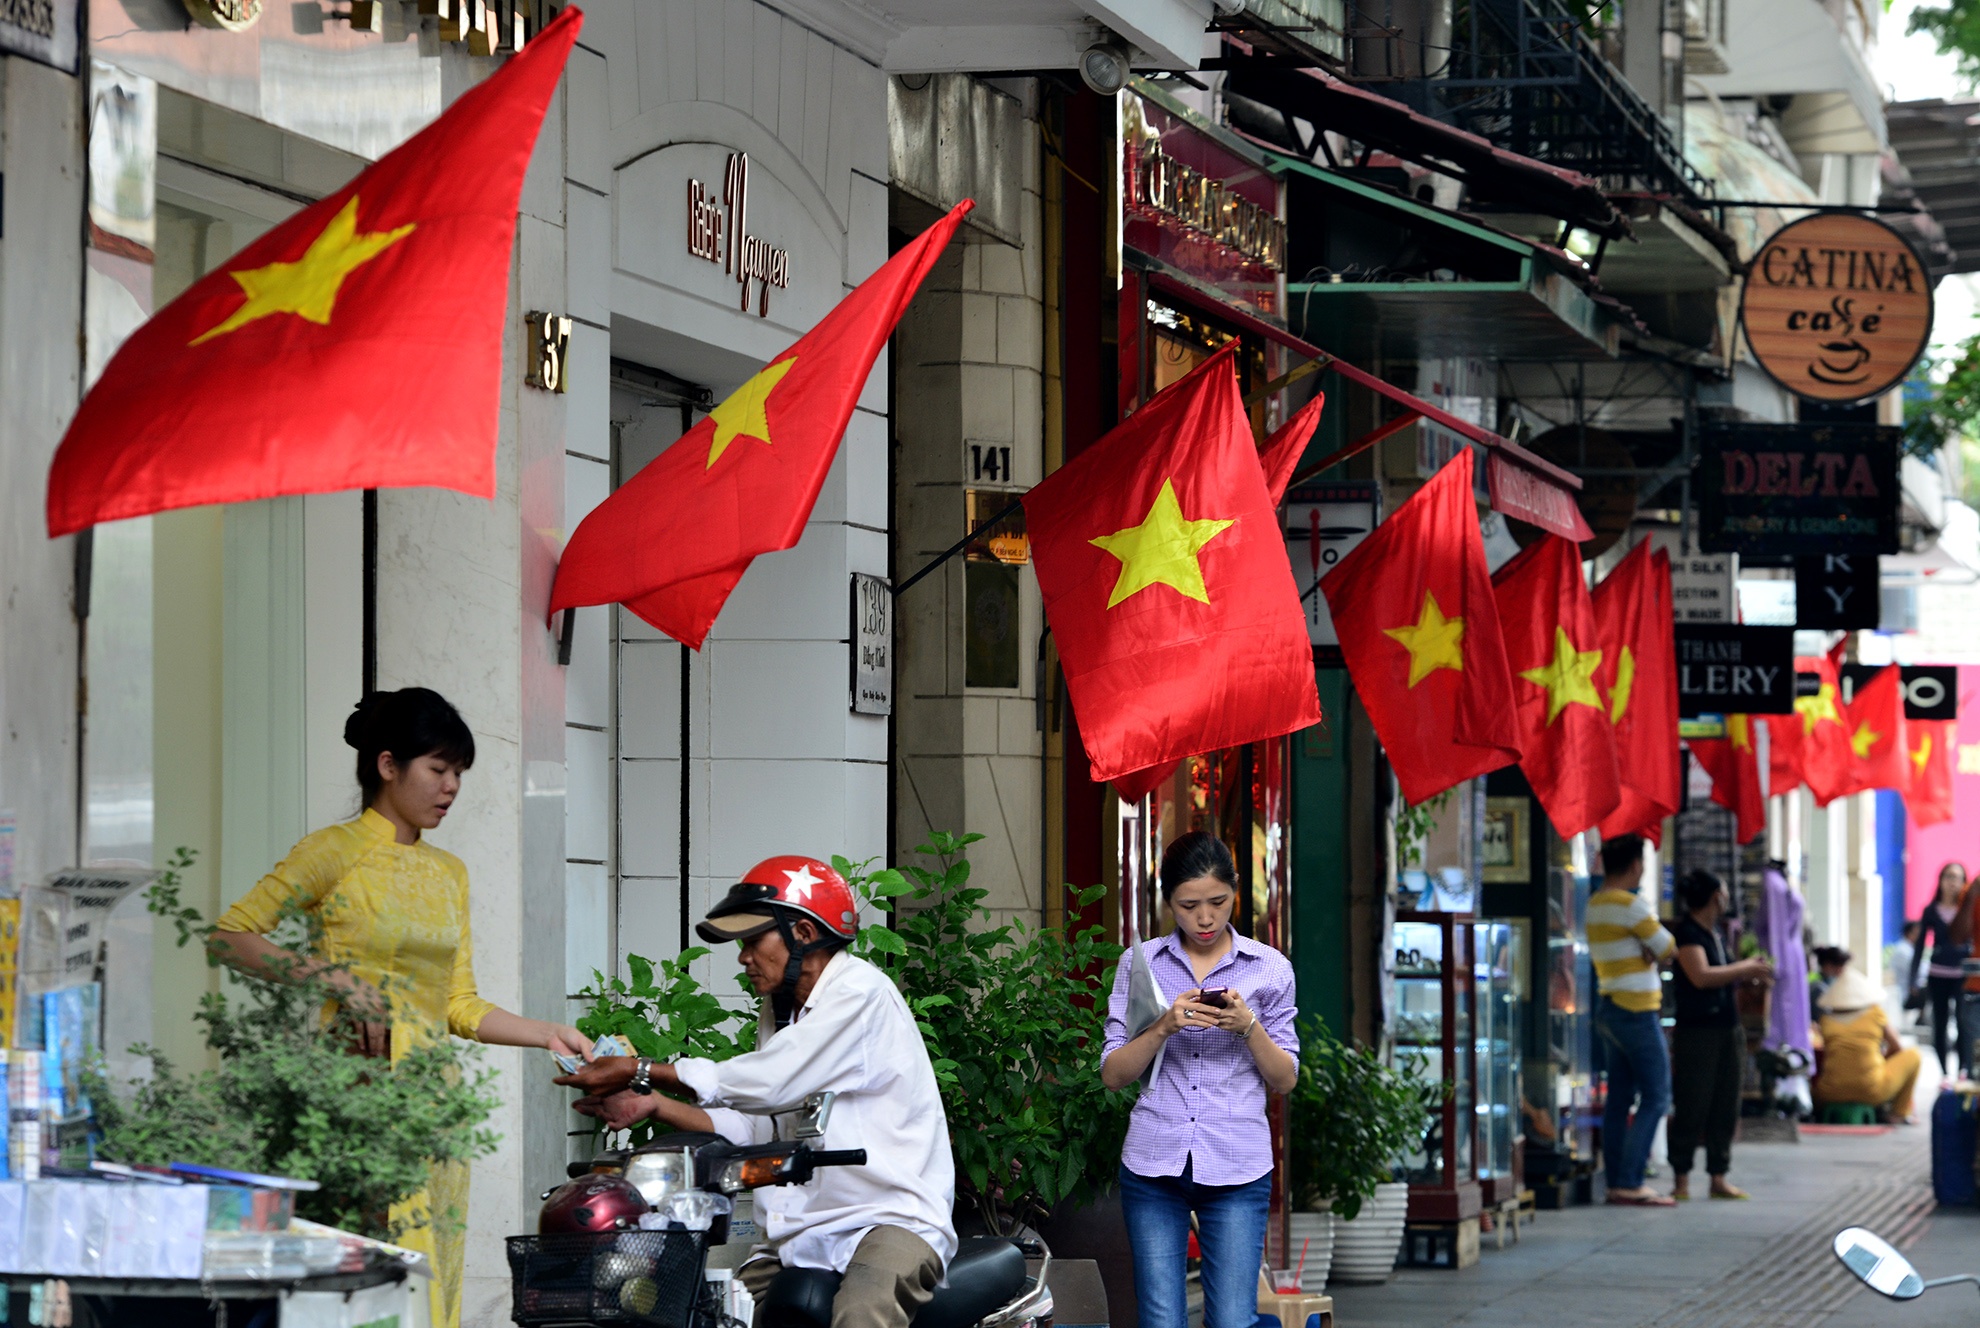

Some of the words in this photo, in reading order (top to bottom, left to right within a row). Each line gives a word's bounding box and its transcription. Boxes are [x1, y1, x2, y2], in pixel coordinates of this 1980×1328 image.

[724, 152, 789, 318] Nguyen
[1762, 245, 1915, 293] CATINA
[971, 445, 1010, 482] 141
[1721, 451, 1880, 498] DELTA
[862, 580, 886, 636] 139
[1680, 639, 1742, 663] THANH
